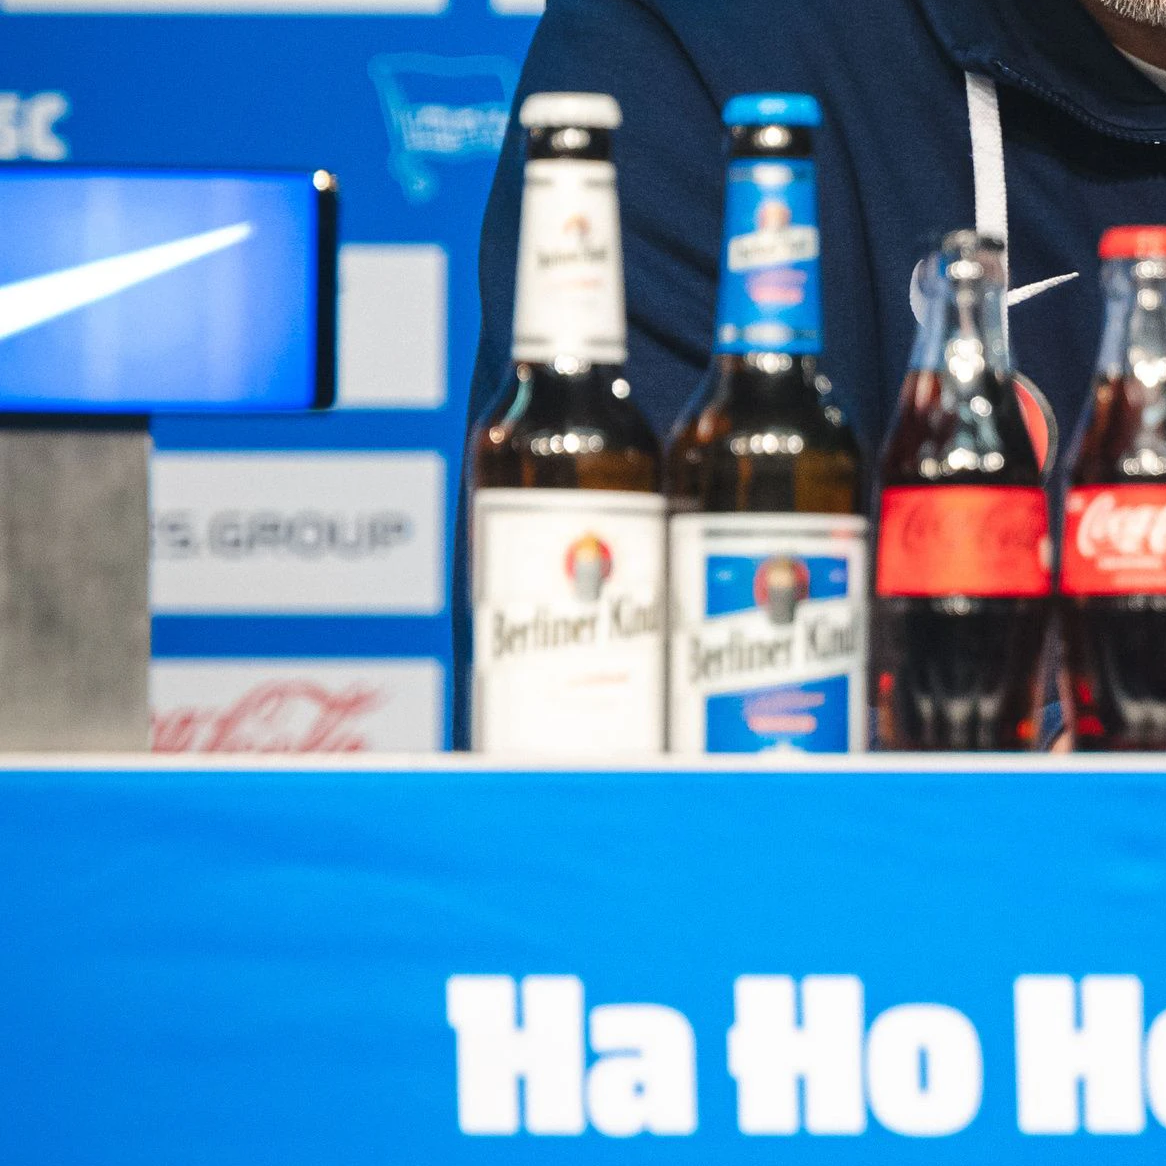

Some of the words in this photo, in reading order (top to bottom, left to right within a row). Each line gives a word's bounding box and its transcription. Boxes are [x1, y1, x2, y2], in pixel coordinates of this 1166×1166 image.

[208, 508, 414, 561] GROUP
[446, 974, 699, 1137] Ha
[728, 974, 985, 1137] Ho
